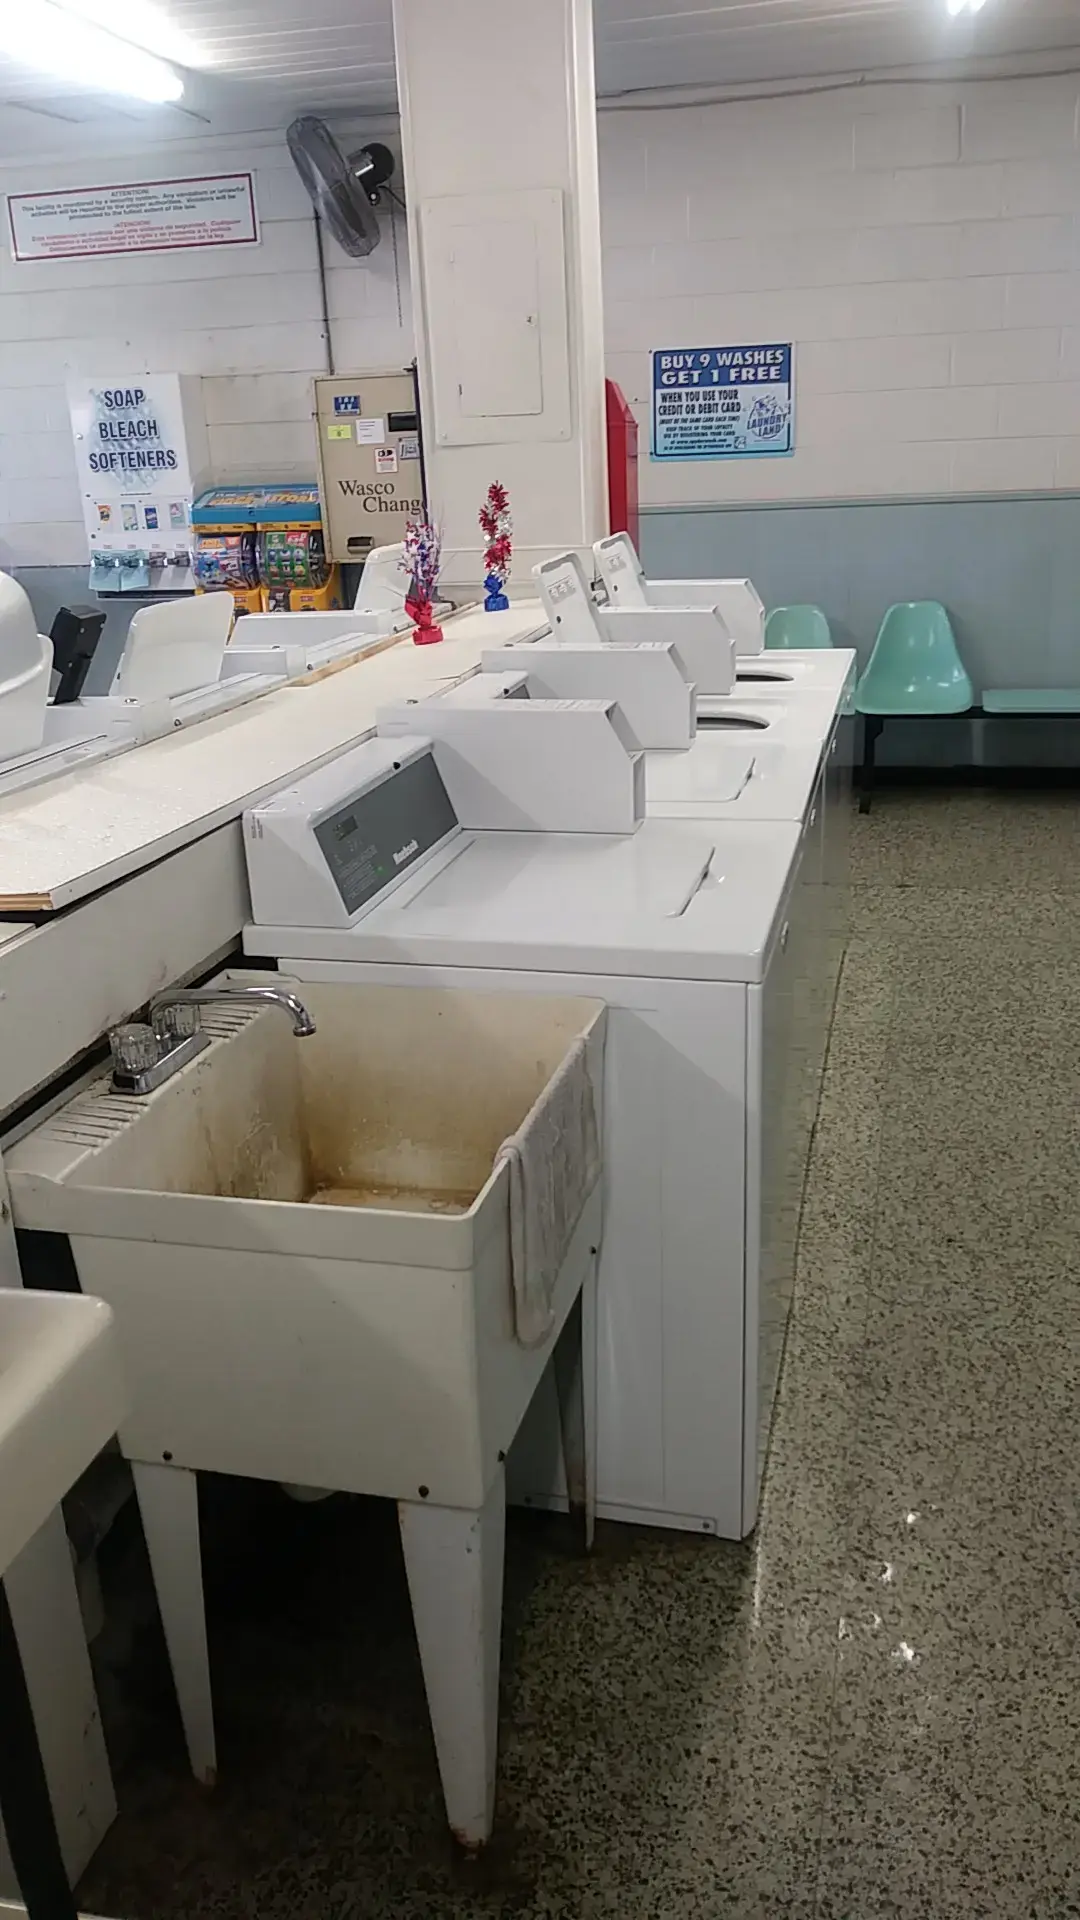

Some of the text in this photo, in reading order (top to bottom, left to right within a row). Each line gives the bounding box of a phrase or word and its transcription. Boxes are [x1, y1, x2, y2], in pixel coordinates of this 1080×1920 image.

[661, 350, 784, 369] BUY 9 WASHES
[661, 366, 781, 385] GET 1 FREE
[104, 389, 146, 408] SOAP
[660, 389, 739, 403] WHEN YOU USE YOUR
[659, 401, 741, 416] CREDIT OR DEBIT CARD
[99, 419, 159, 439] BLEACH
[747, 413, 787, 430] LAUNDRY
[759, 424, 780, 437] LAND
[89, 450, 177, 470] SOFTENERS
[338, 480, 395, 496] Wasco
